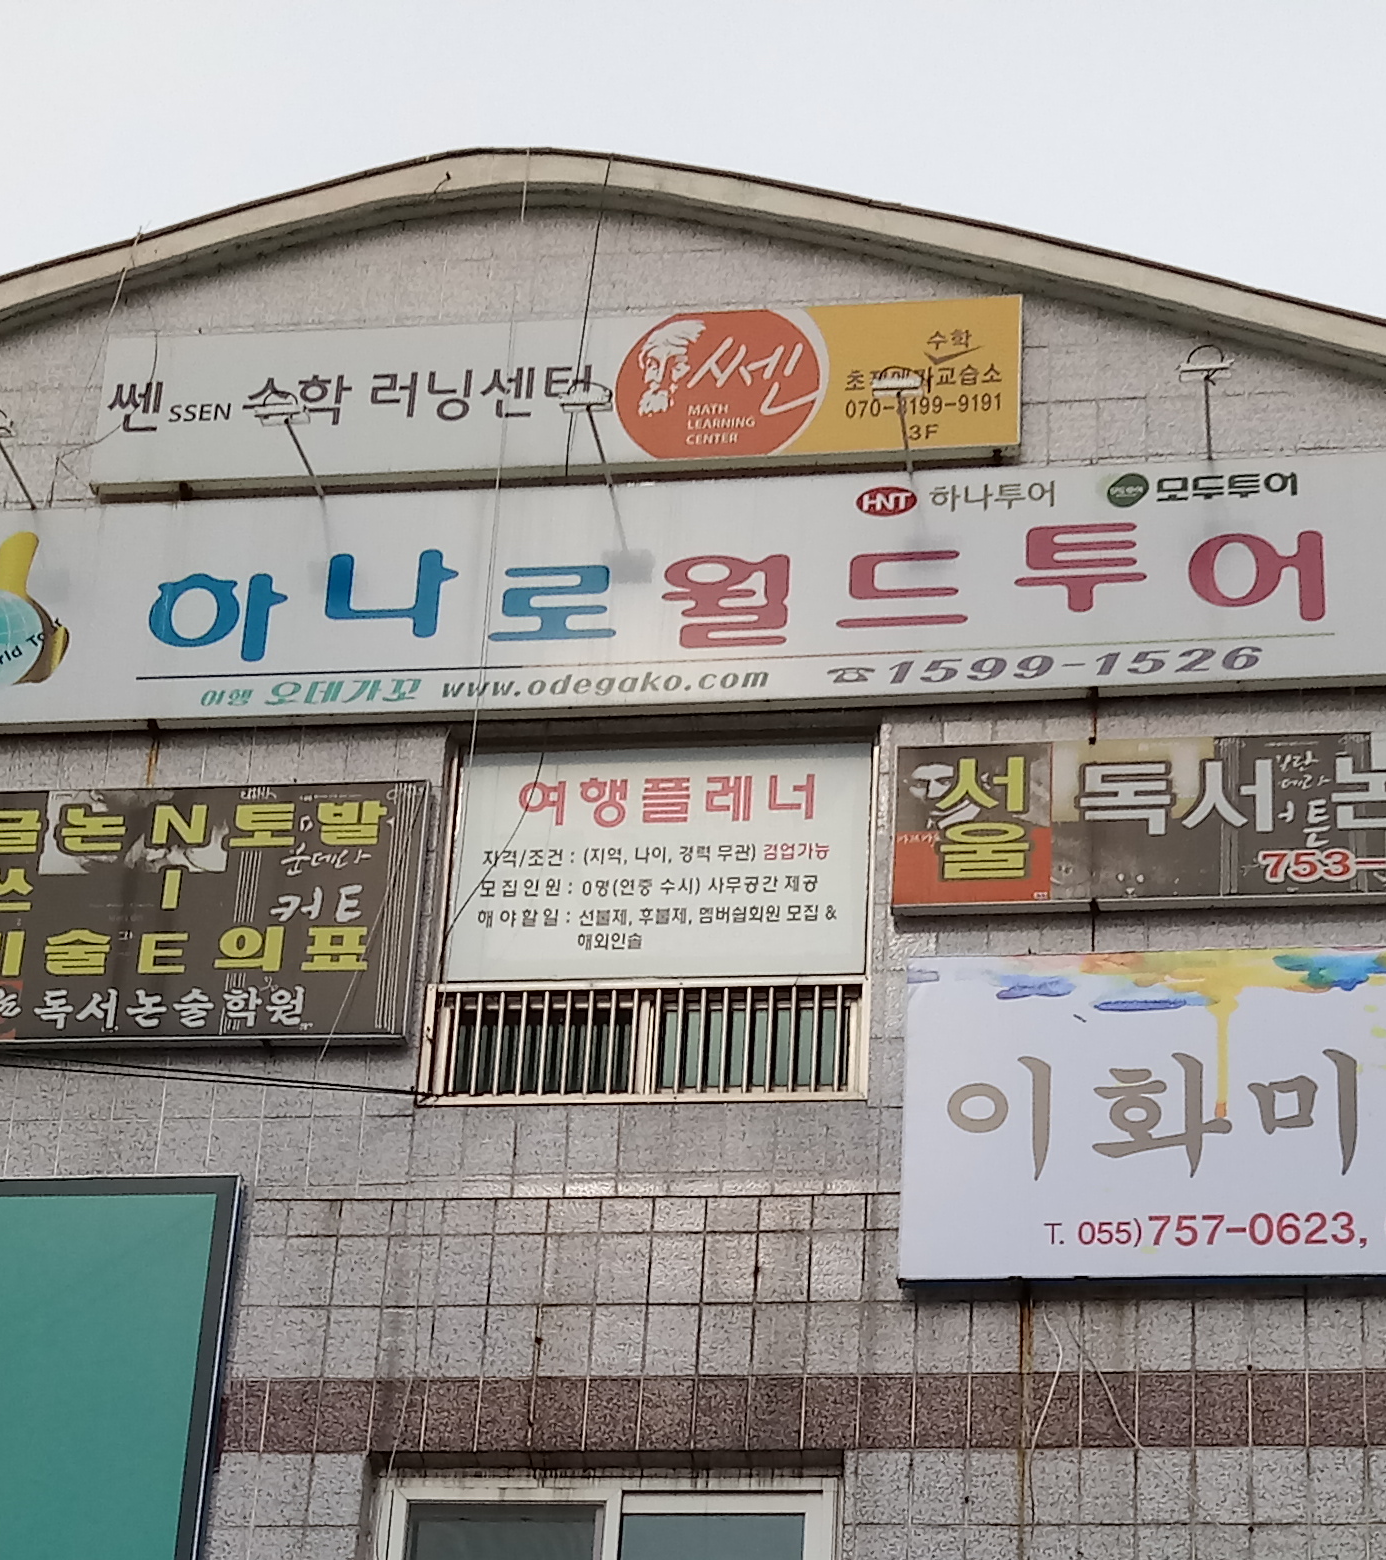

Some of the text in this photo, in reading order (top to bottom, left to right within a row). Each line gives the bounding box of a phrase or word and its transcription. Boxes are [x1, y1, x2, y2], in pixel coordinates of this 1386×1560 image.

[926, 328, 973, 350] 수학
[108, 382, 164, 433] 쎈
[167, 402, 232, 423] SSEN
[686, 403, 730, 417] MATH
[685, 417, 757, 431] LEARNING
[908, 423, 939, 442] 3F
[685, 433, 739, 447] CENTER
[929, 480, 1057, 512] 하나투어
[1157, 471, 1300, 503] 모두투어
[889, 644, 1265, 686] 1599-1526
[441, 669, 771, 699] www.odegako.com
[517, 772, 816, 828] 여행플레너
[634, 845, 673, 865] 나이,
[678, 844, 712, 864] 경력
[717, 843, 757, 863] 무관)
[660, 876, 701, 896] 수시)
[707, 875, 779, 895] 사무공간
[783, 874, 819, 894] 제공
[785, 903, 819, 923] 모집
[824, 903, 838, 921] &
[577, 931, 643, 951] 해외인솔
